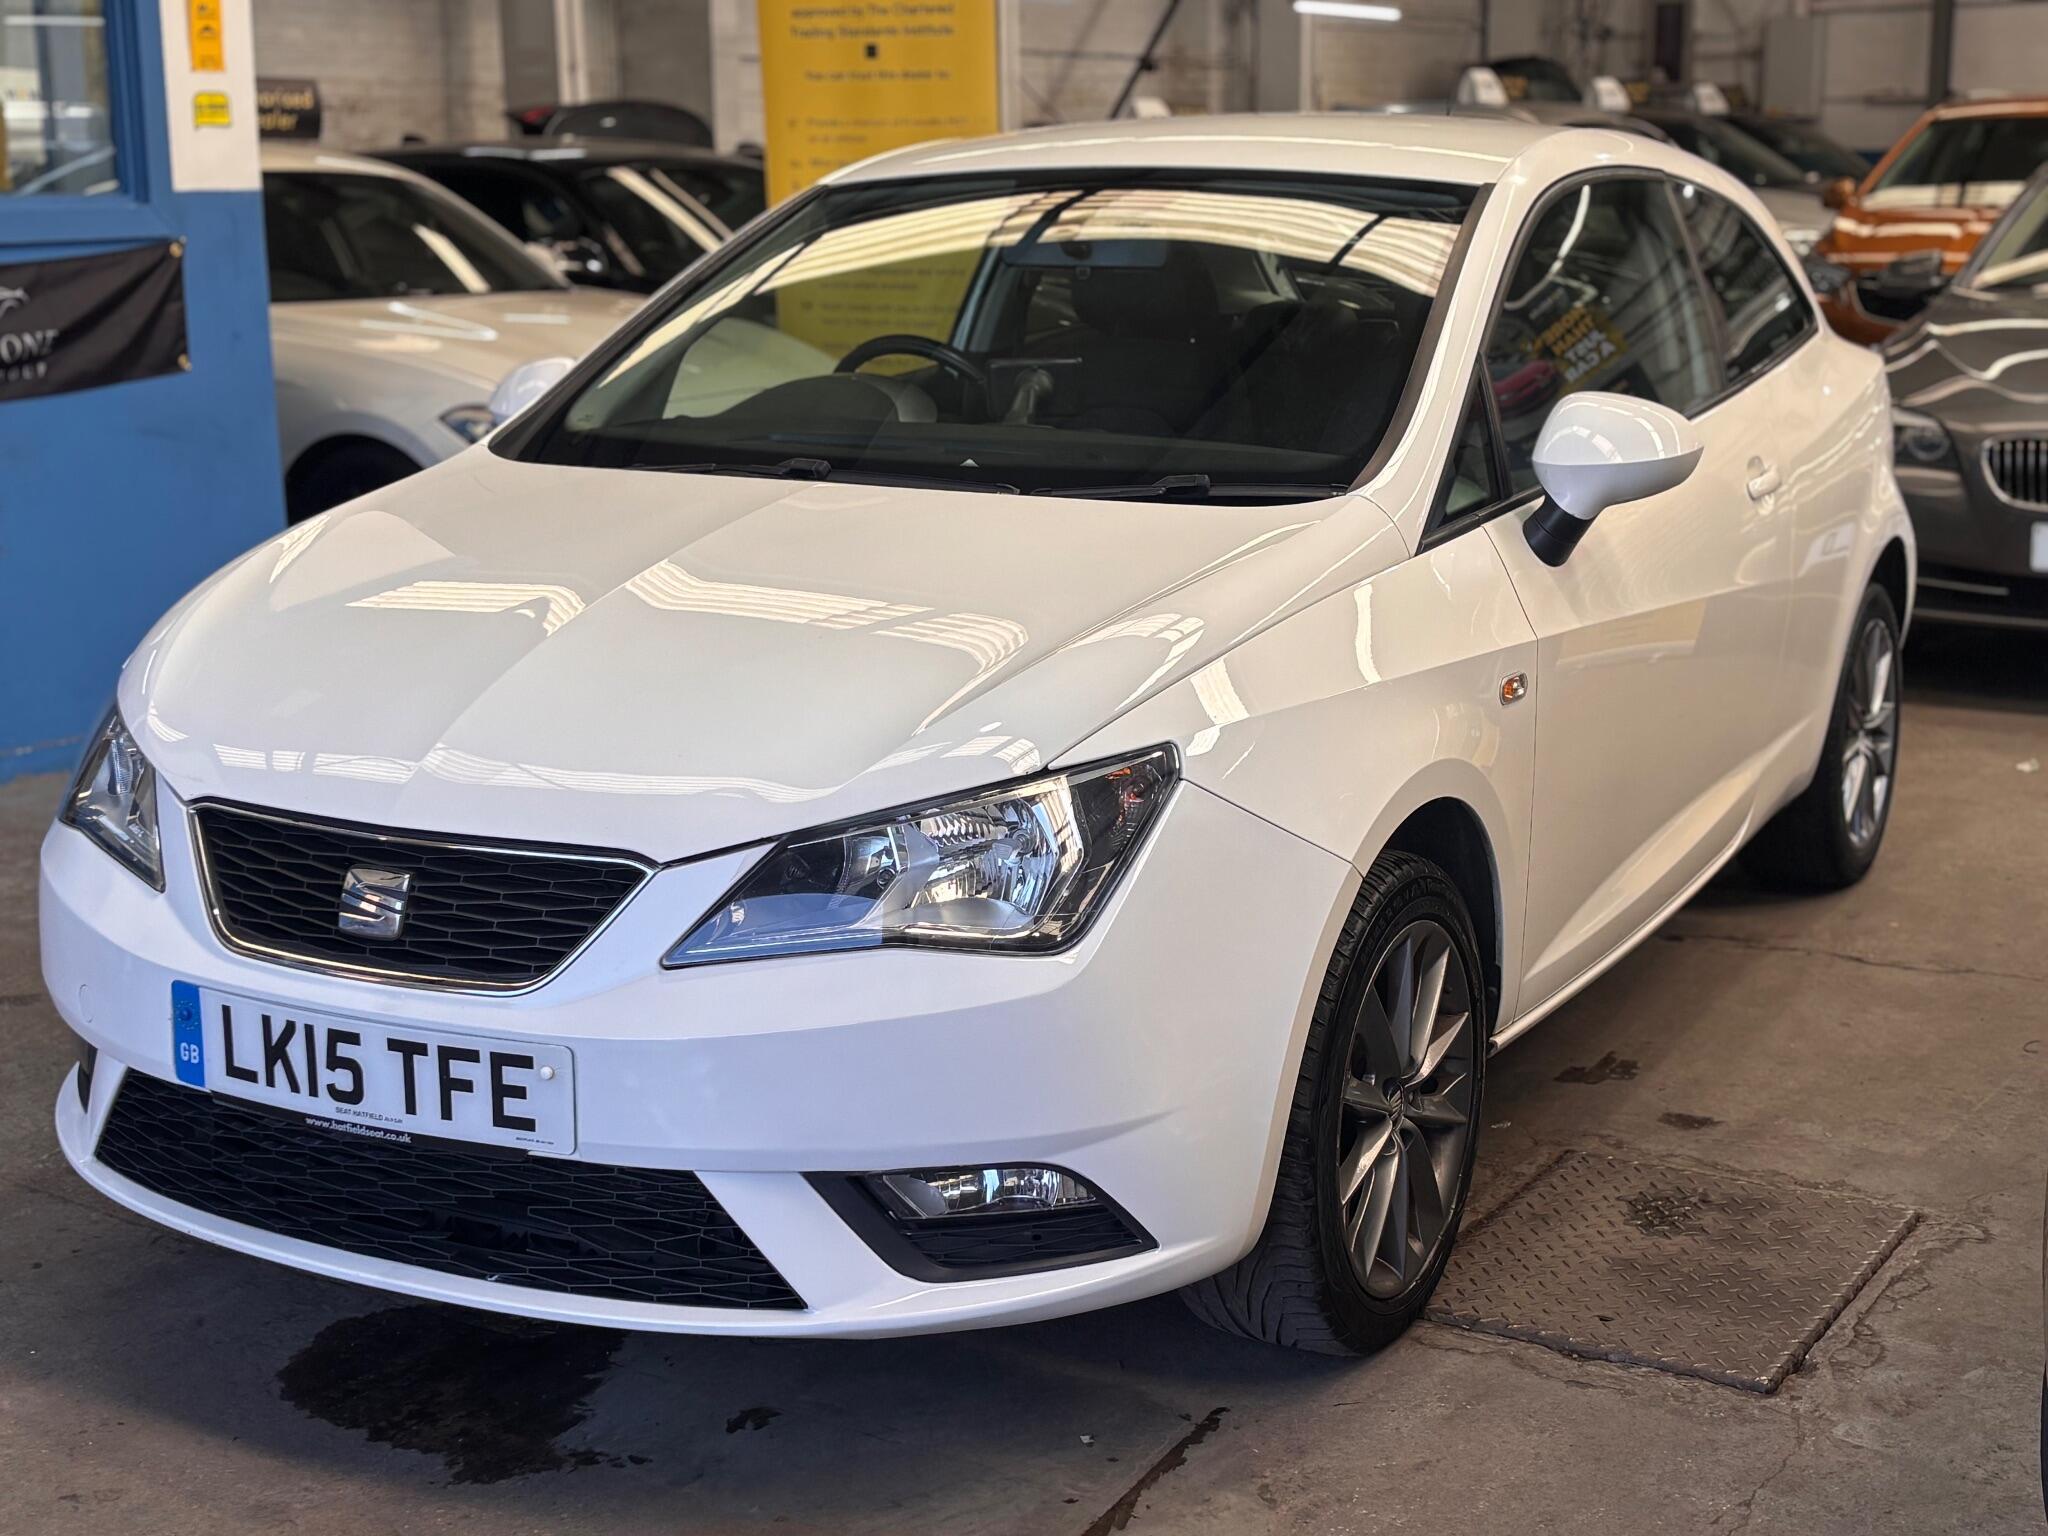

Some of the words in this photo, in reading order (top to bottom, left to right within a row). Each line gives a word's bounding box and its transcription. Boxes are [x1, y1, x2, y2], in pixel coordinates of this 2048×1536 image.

[180, 1041, 200, 1064] GB
[221, 1004, 365, 1106] LK15
[386, 1037, 537, 1133] TFE
[305, 1117, 412, 1144] www.hatfieldseat.co.uk
